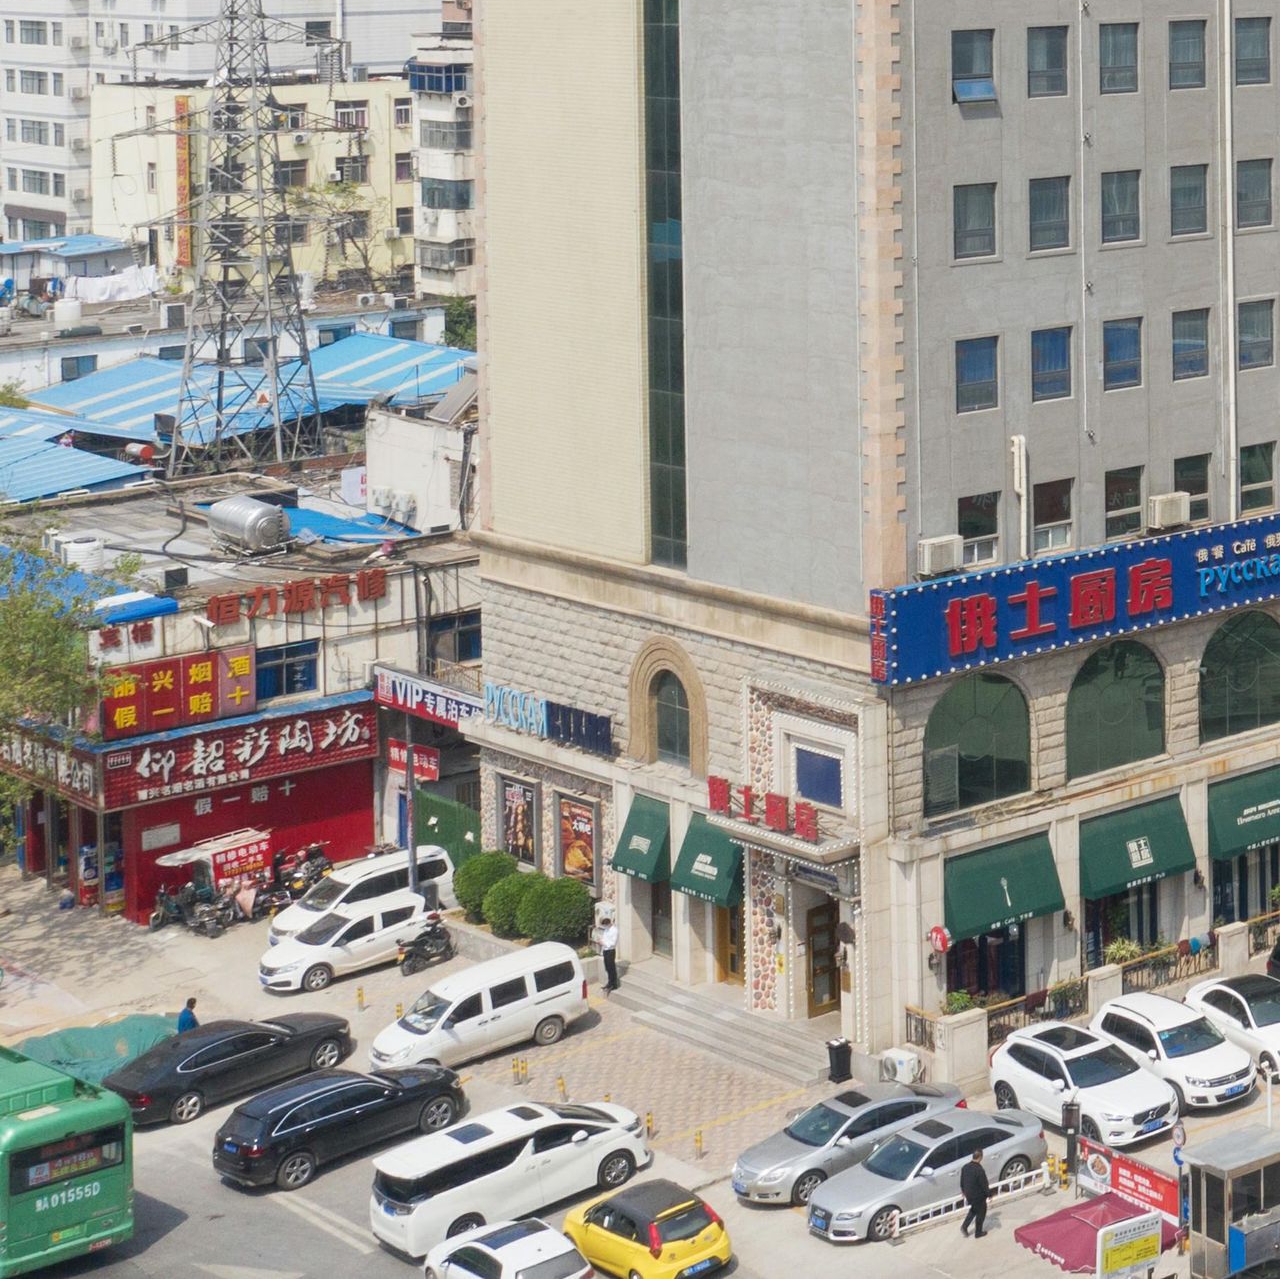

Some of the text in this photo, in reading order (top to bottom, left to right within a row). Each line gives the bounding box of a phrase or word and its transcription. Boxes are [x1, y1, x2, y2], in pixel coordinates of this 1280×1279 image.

[207, 568, 387, 626] 恒力源汽修
[944, 557, 1173, 657] 俄士厨房
[113, 685, 250, 730] 假一赔十
[136, 710, 364, 783] 仰韶彩陶坊
[194, 780, 296, 816] 假一赔十
